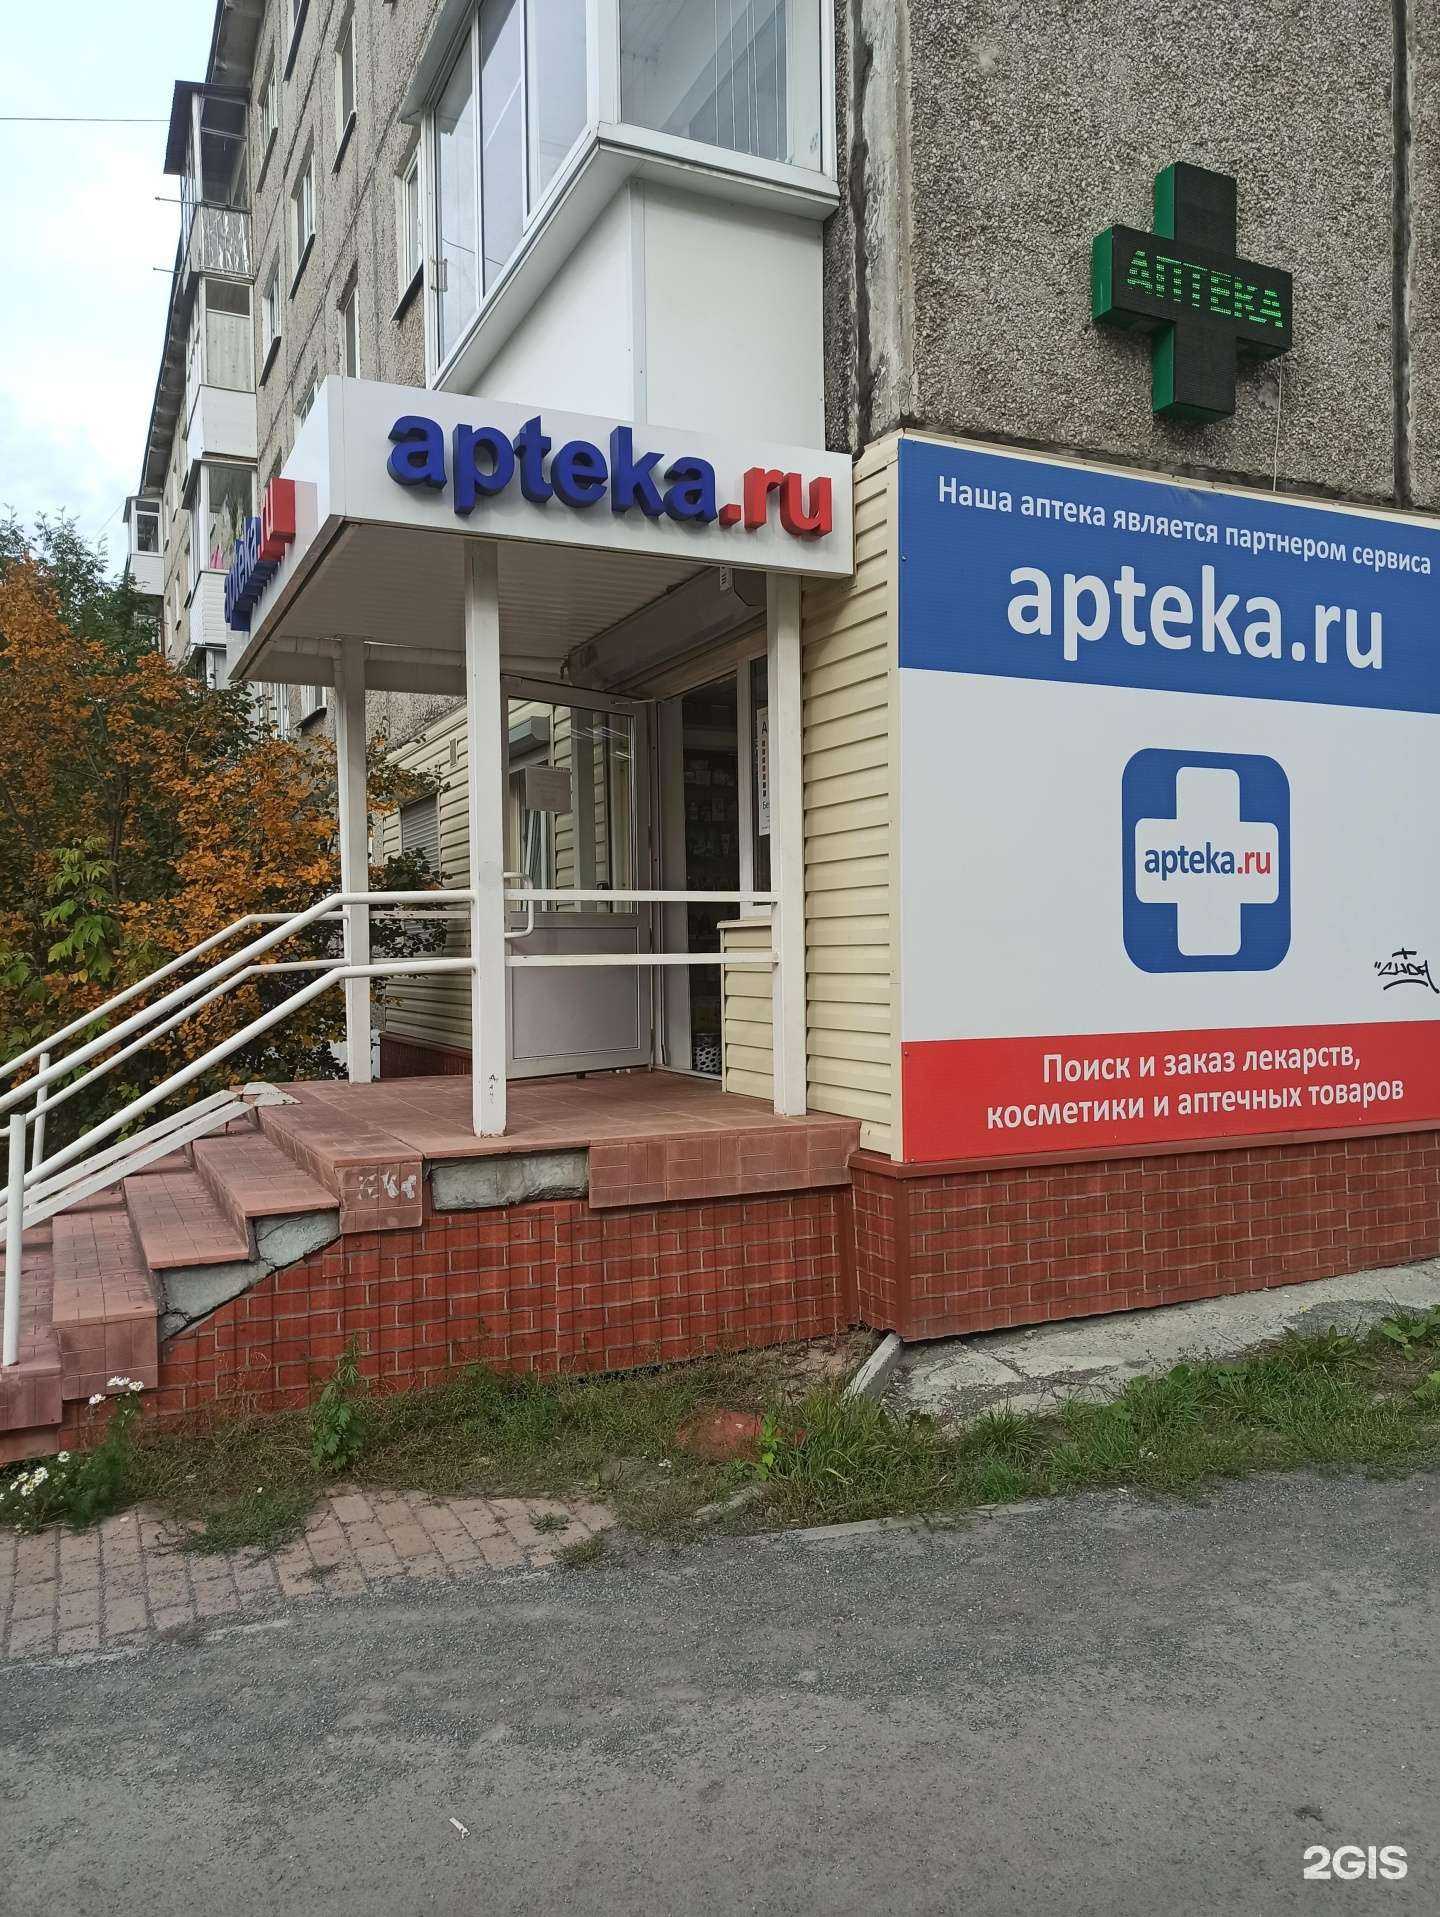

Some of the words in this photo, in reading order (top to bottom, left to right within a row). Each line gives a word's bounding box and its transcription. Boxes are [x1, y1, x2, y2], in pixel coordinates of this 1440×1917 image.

[1127, 250, 1284, 328] АПТЕКА
[387, 415, 832, 537] apteka.ru
[939, 475, 1012, 512] Наша
[1020, 491, 1106, 527] аптека
[1113, 509, 1218, 544] является
[1225, 527, 1347, 562] партнером
[1352, 546, 1431, 575] сервиса
[1007, 564, 1383, 670] apteka.ru
[1144, 841, 1271, 881] apteka.ru
[1042, 1053, 1131, 1083] Поиск
[1139, 1054, 1156, 1077] и
[1163, 1049, 1236, 1076] заказ
[1242, 1045, 1361, 1074] лекарств,
[986, 1094, 1144, 1130] косметики
[1153, 1094, 1169, 1118] и
[1177, 1085, 1302, 1115] аптечных
[1308, 1079, 1405, 1110] товаров
